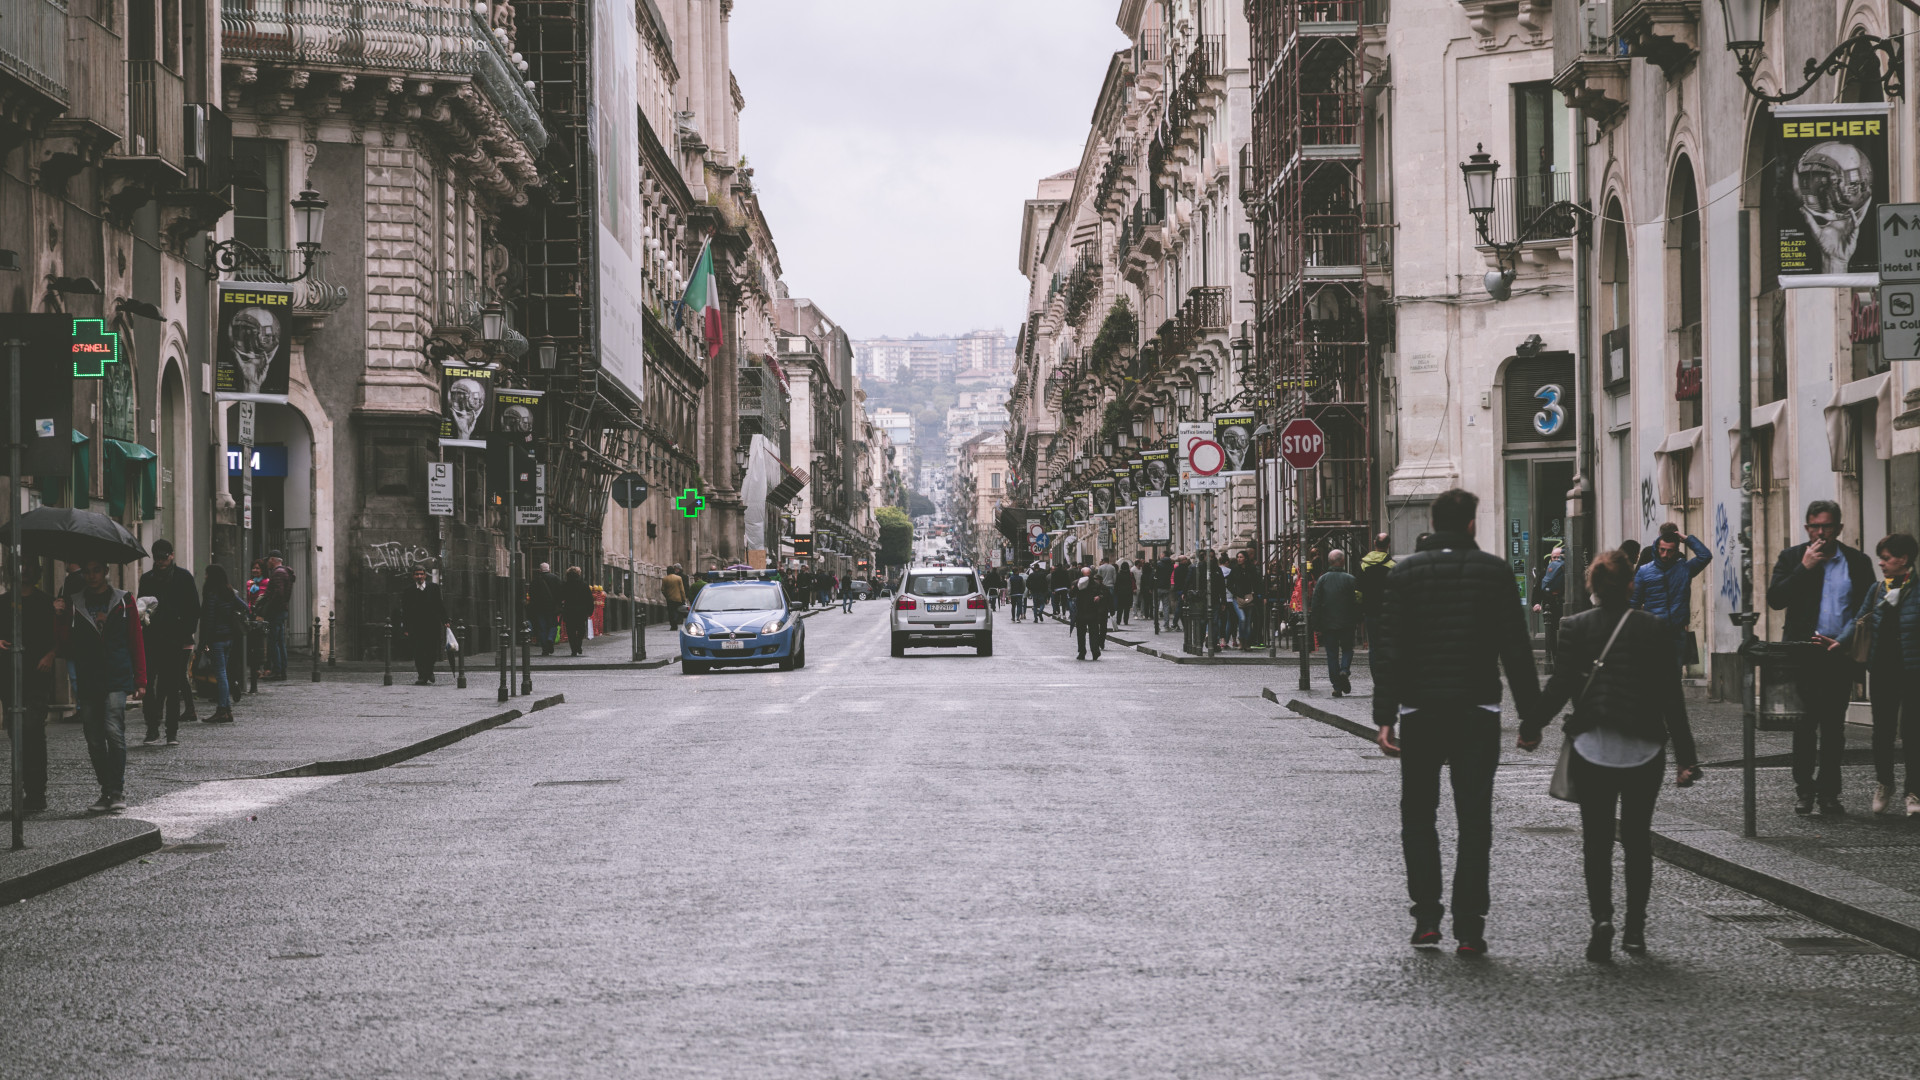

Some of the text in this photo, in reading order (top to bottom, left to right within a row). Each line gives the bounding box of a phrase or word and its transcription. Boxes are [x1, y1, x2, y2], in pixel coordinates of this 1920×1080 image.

[1783, 120, 1880, 138] ESCHER
[1883, 262, 1913, 272] Hotel
[224, 292, 288, 306] ESCHER
[1884, 320, 1896, 330] La
[445, 368, 491, 378] ESCHER
[499, 395, 539, 405] ESCHER
[1533, 384, 1565, 436] 3
[1284, 434, 1322, 454] STOP
